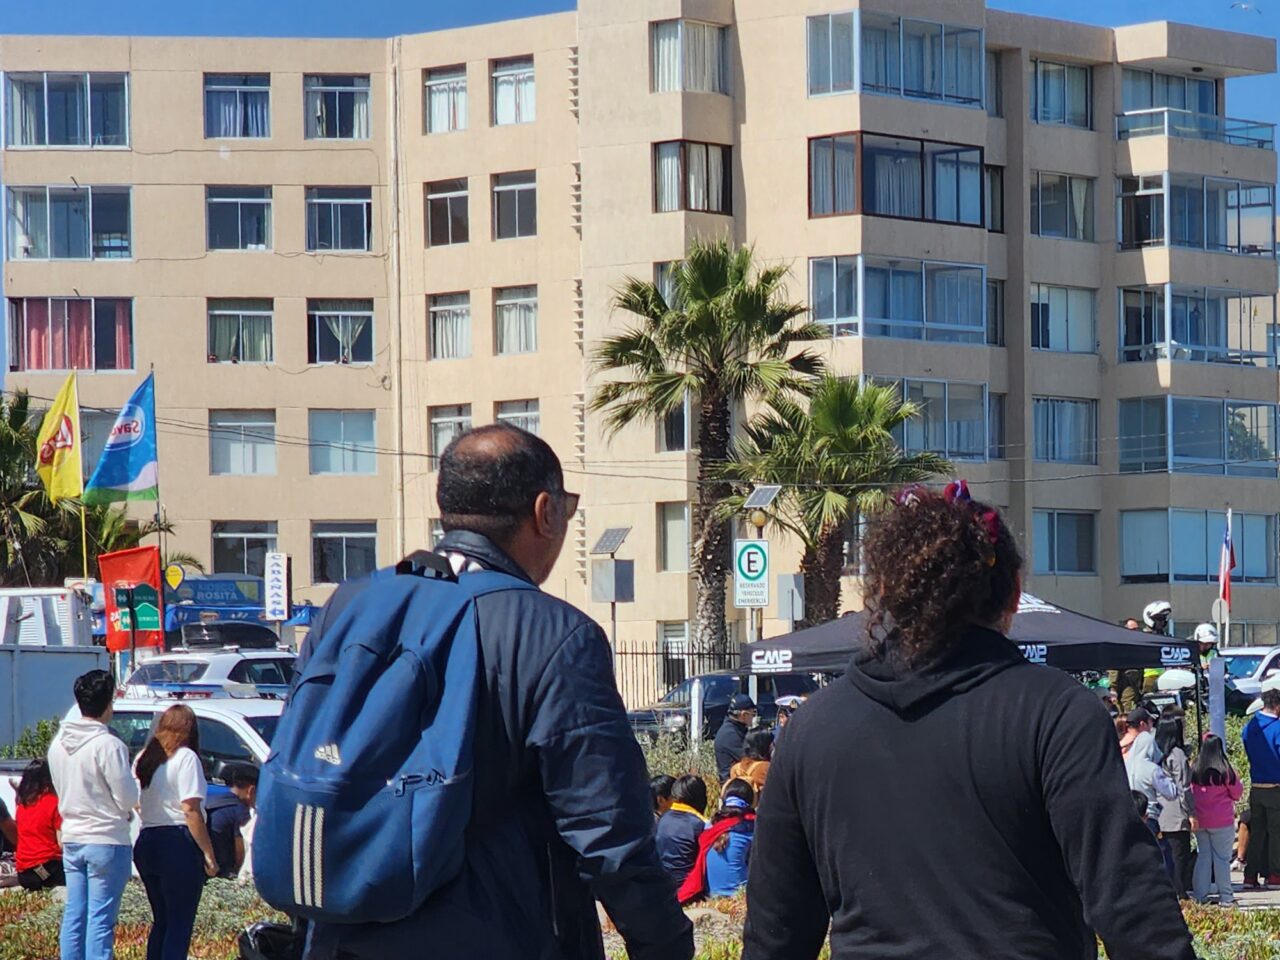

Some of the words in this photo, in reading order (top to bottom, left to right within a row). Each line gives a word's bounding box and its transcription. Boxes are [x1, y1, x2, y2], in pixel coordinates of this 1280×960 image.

[747, 552, 758, 573] E
[197, 591, 238, 600] ROSITA
[751, 649, 793, 666] CMP
[1161, 646, 1191, 661] CMP
